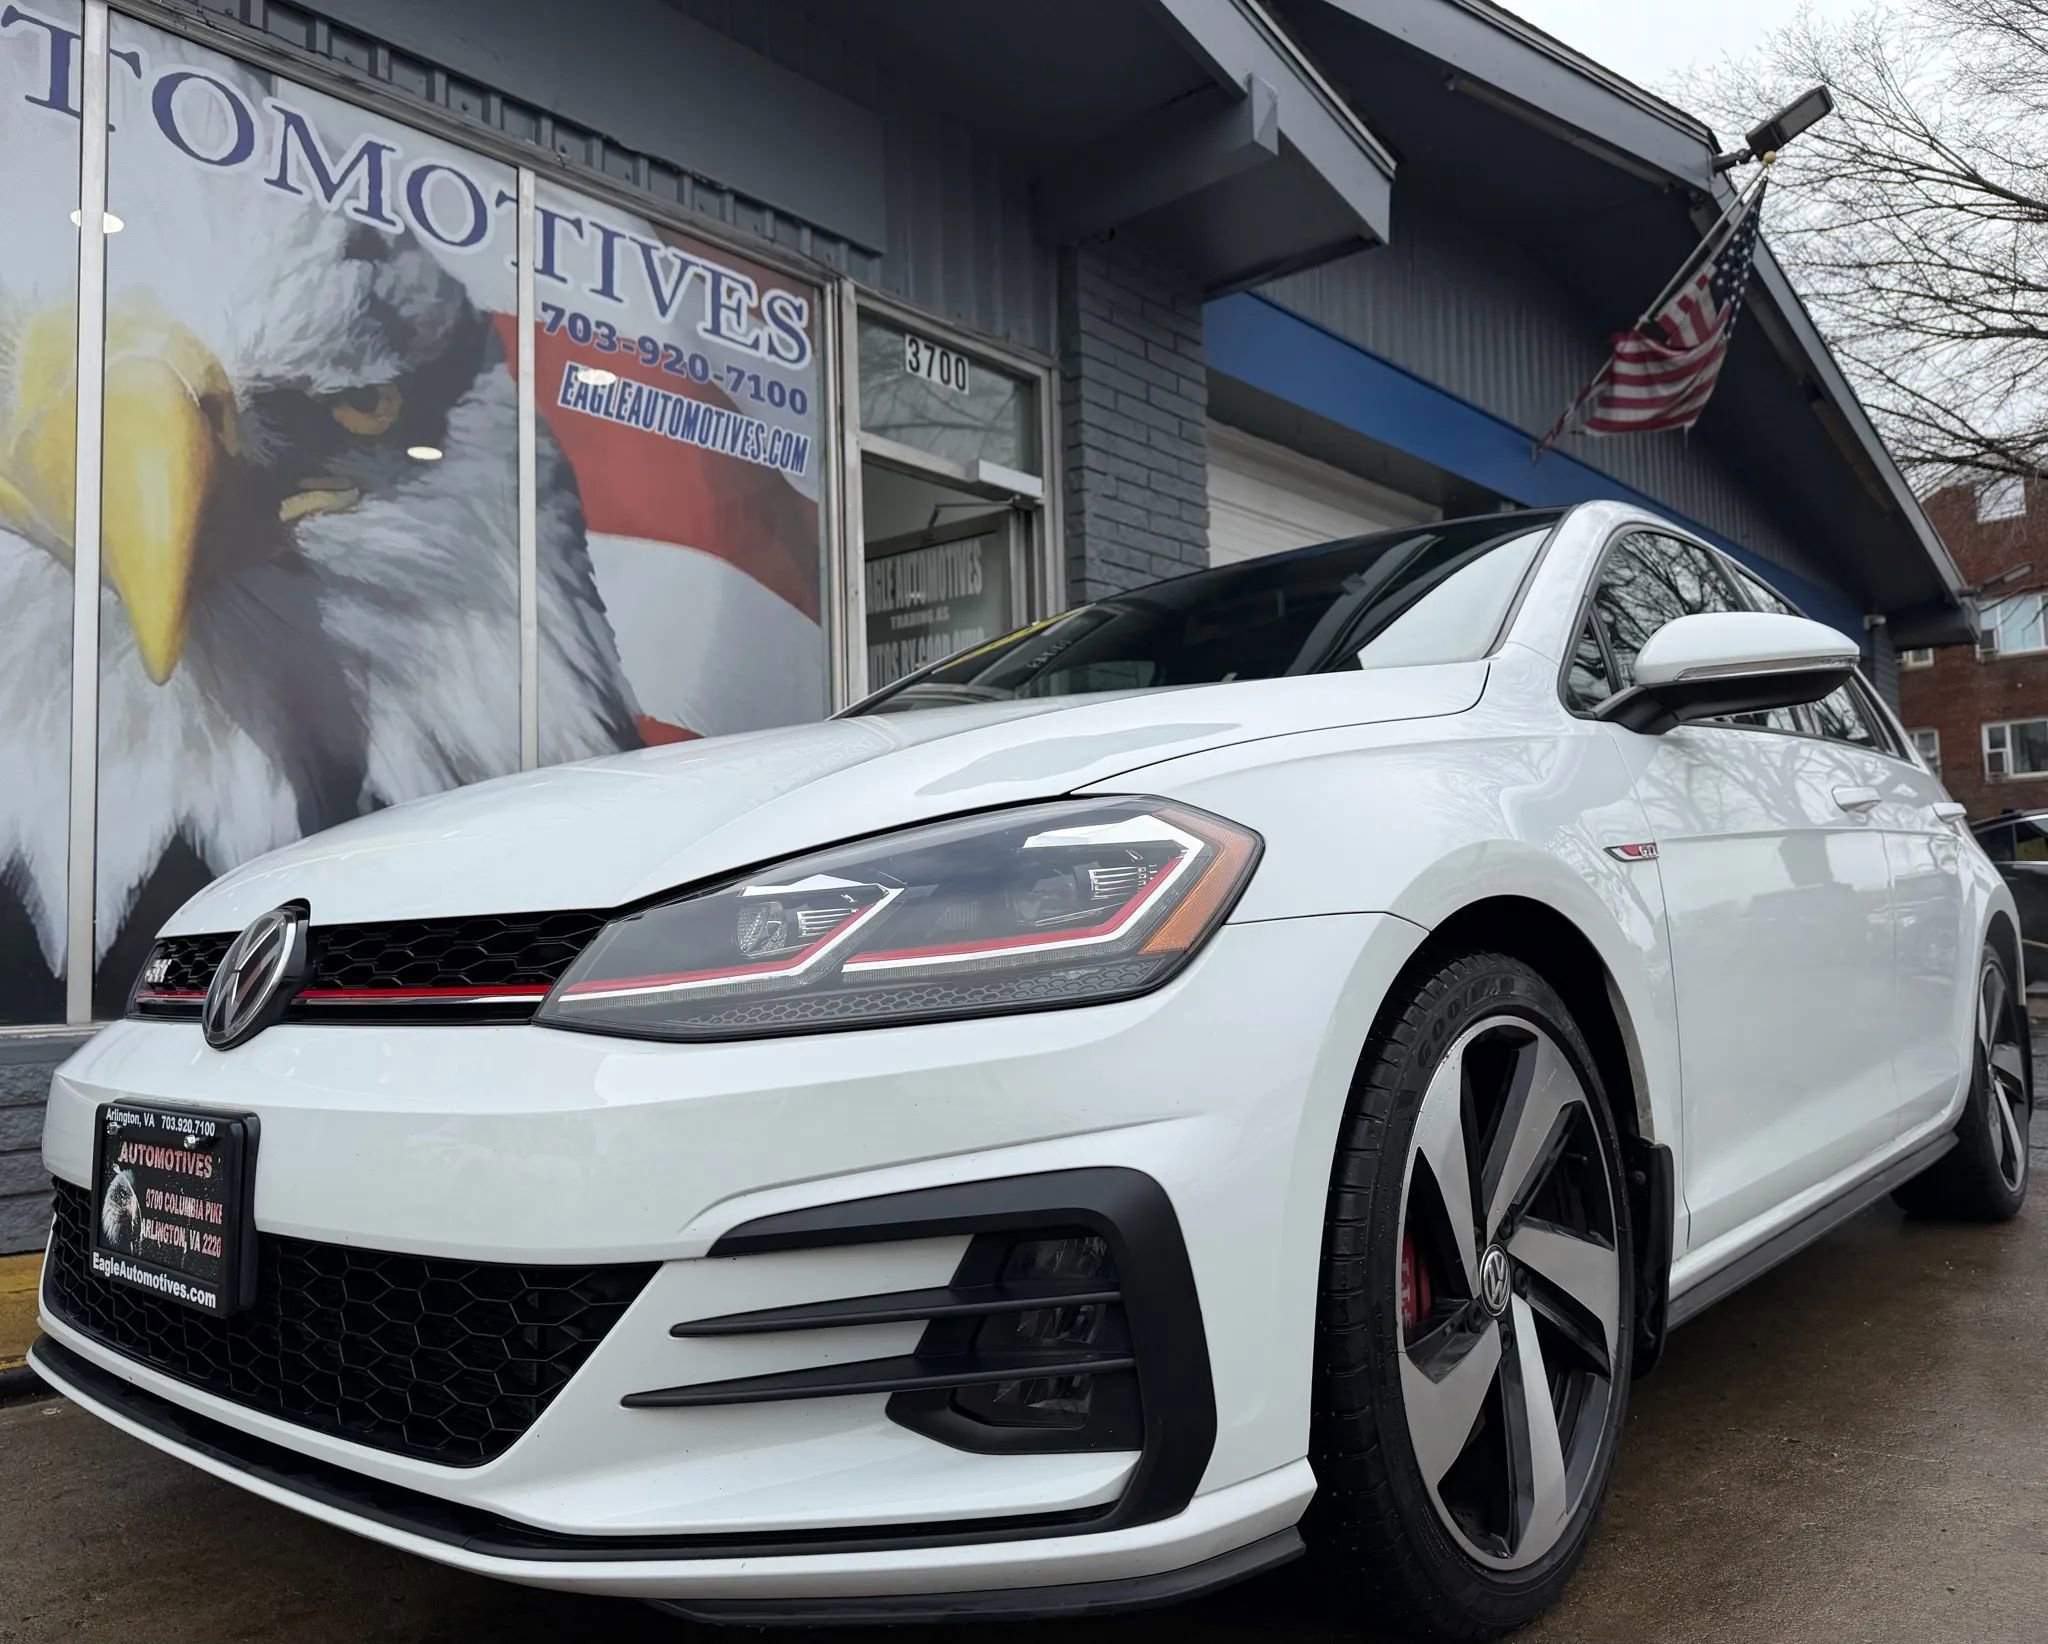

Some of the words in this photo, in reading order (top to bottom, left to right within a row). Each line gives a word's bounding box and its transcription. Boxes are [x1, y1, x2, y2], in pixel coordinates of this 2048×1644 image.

[541, 303, 808, 416] 703-920-7100
[907, 337, 967, 392] 3700
[560, 363, 810, 475] EAGLEAUTOMOTIVES.COM
[106, 1107, 141, 1127] Arlington,
[144, 1112, 155, 1128] VA
[161, 1115, 216, 1136] 703.920.7100
[119, 1141, 213, 1178] AUTOMOTIVES
[164, 1192, 203, 1220] COLUMBIA
[205, 1200, 223, 1225] PIKE
[190, 1229, 200, 1252] VA
[93, 1251, 217, 1308] EagleAutomotives.com
